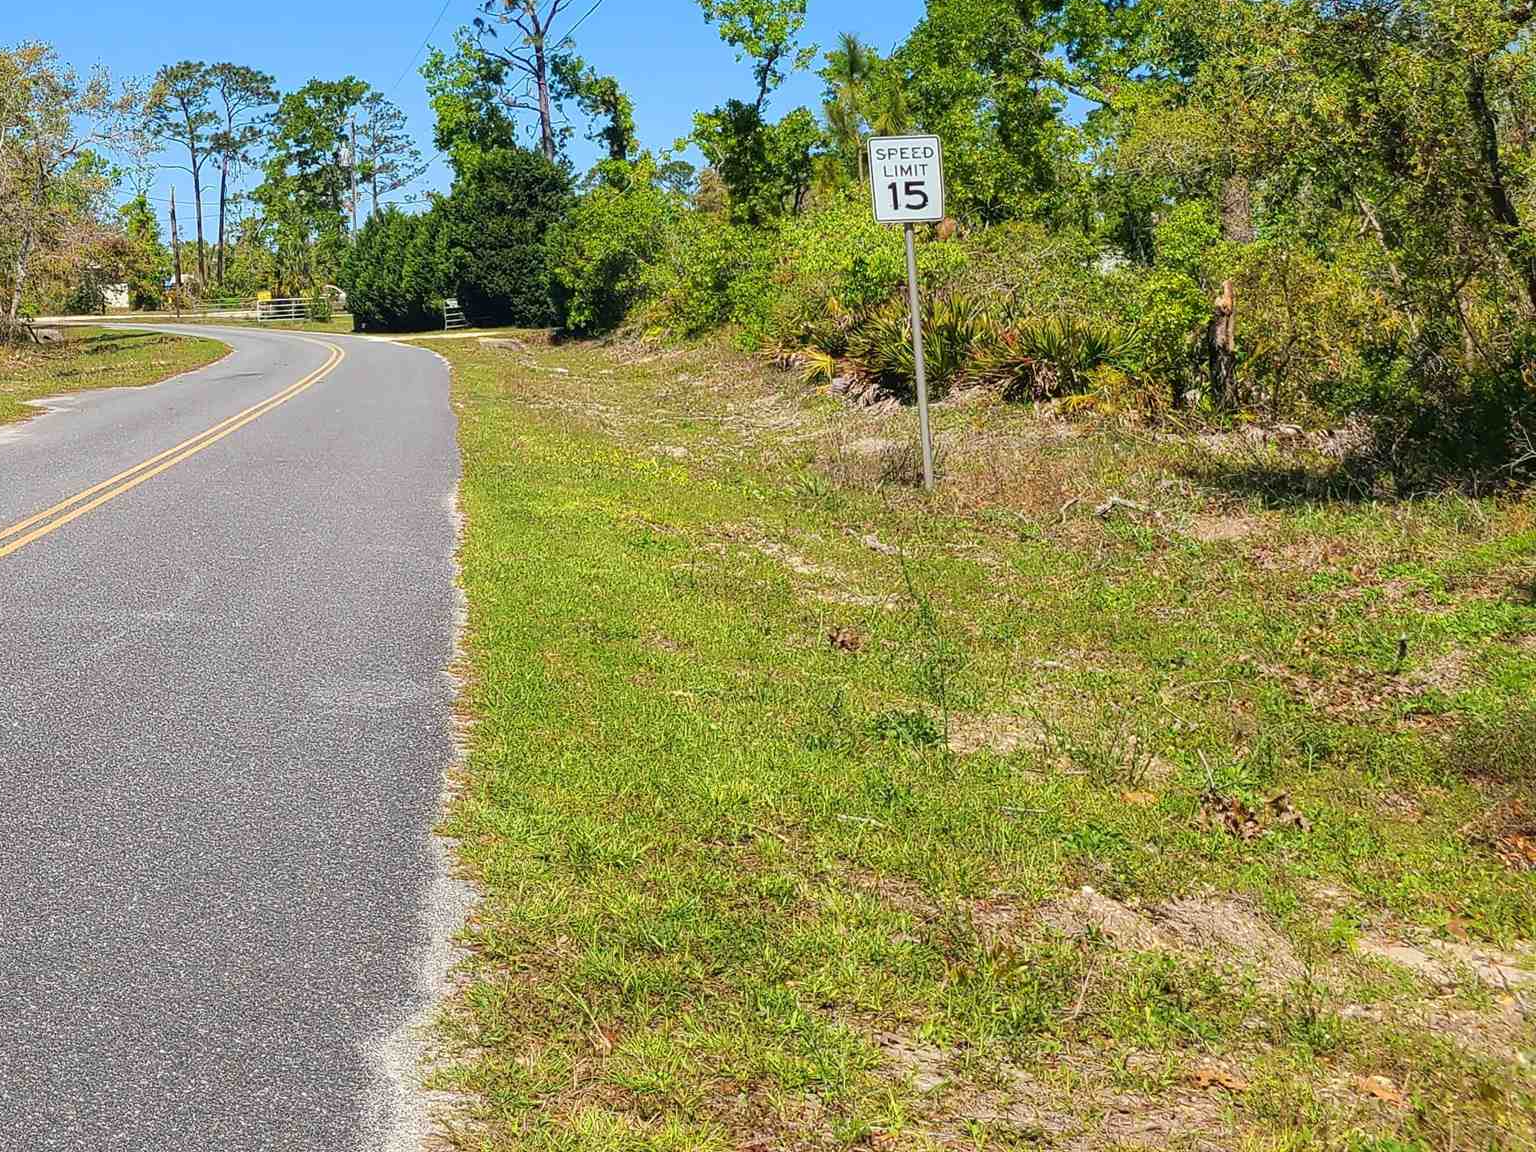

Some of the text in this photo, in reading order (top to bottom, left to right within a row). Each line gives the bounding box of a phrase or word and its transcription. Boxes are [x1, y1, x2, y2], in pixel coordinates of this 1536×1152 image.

[875, 146, 934, 160] SPEED
[883, 164, 928, 177] LIMIT
[887, 181, 929, 210] 15
